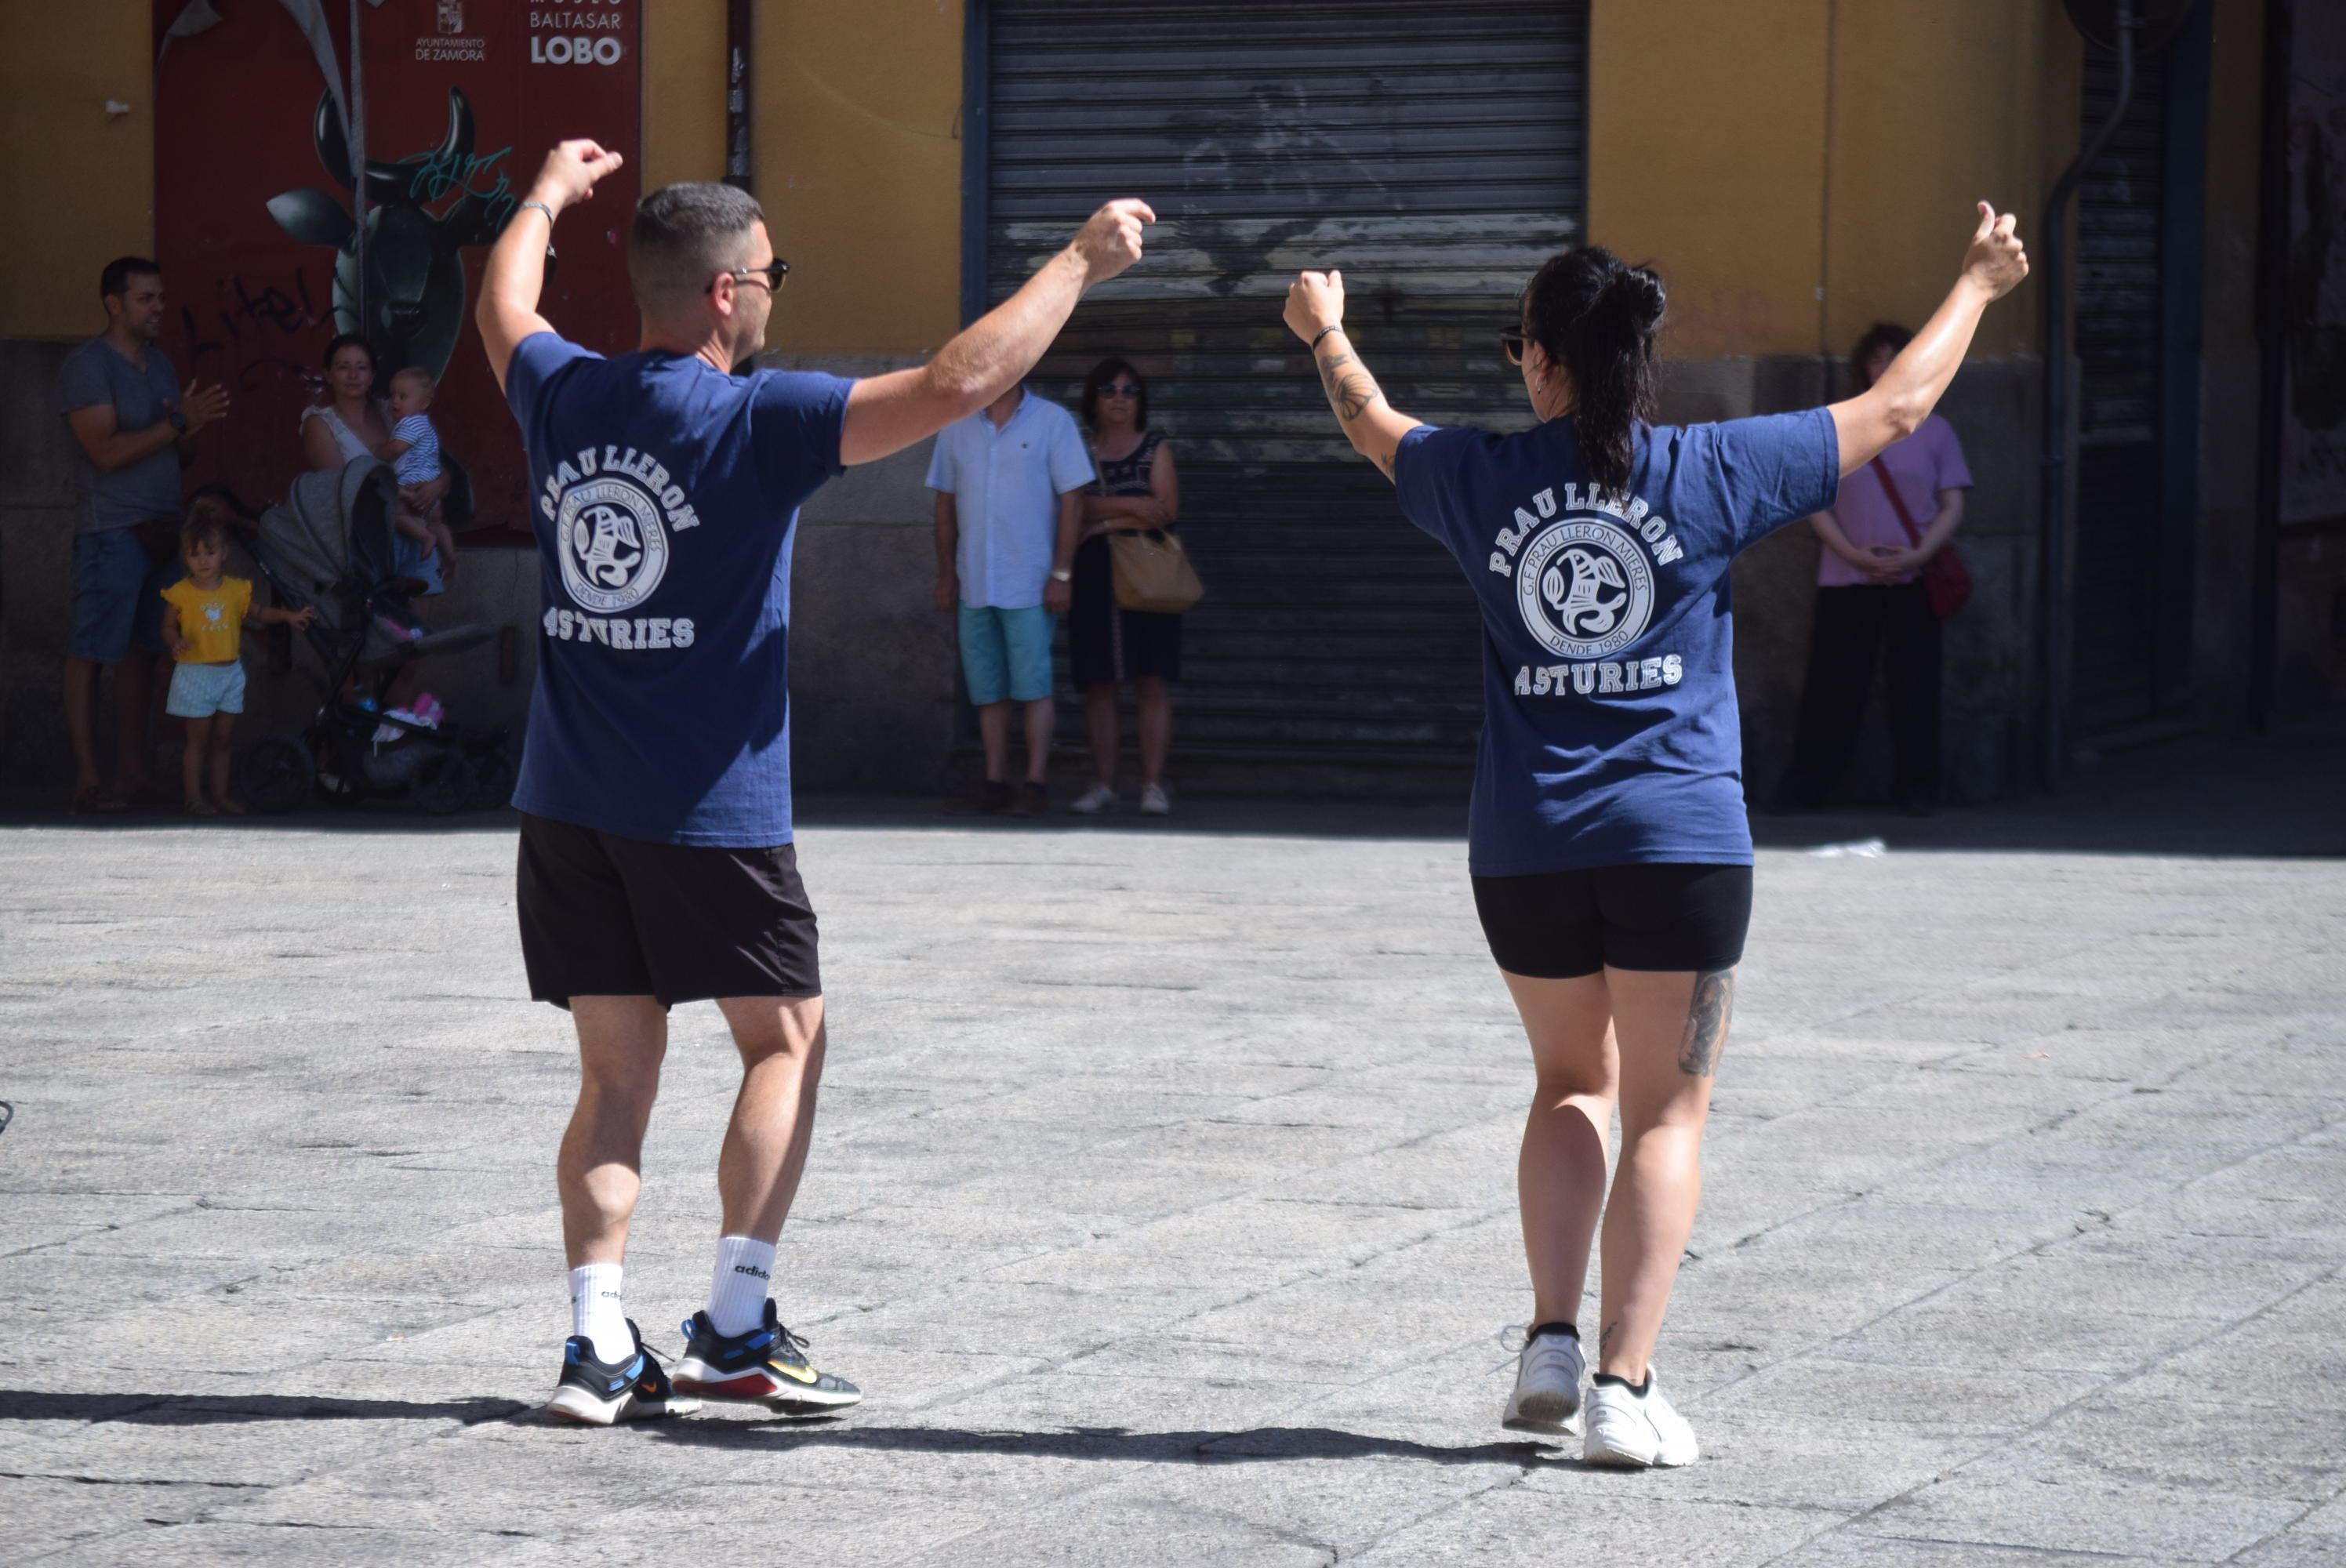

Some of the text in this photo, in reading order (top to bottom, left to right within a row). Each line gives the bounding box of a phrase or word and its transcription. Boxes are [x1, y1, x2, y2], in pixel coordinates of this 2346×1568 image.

[530, 12, 621, 29] BALTASAR
[416, 38, 485, 48] AYUNTAMIENTO
[416, 49, 485, 61] DE ZAMORA
[531, 36, 621, 65] LOBO
[601, 445, 700, 532] LLERON
[1489, 482, 1683, 578] PRAU LLERON
[1527, 533, 1557, 569] PRAU
[1560, 524, 1616, 547] LLERON
[1618, 542, 1647, 591] MIERES
[1549, 630, 1629, 655] DENDE 1980
[1514, 653, 1683, 697] ASTURIES
